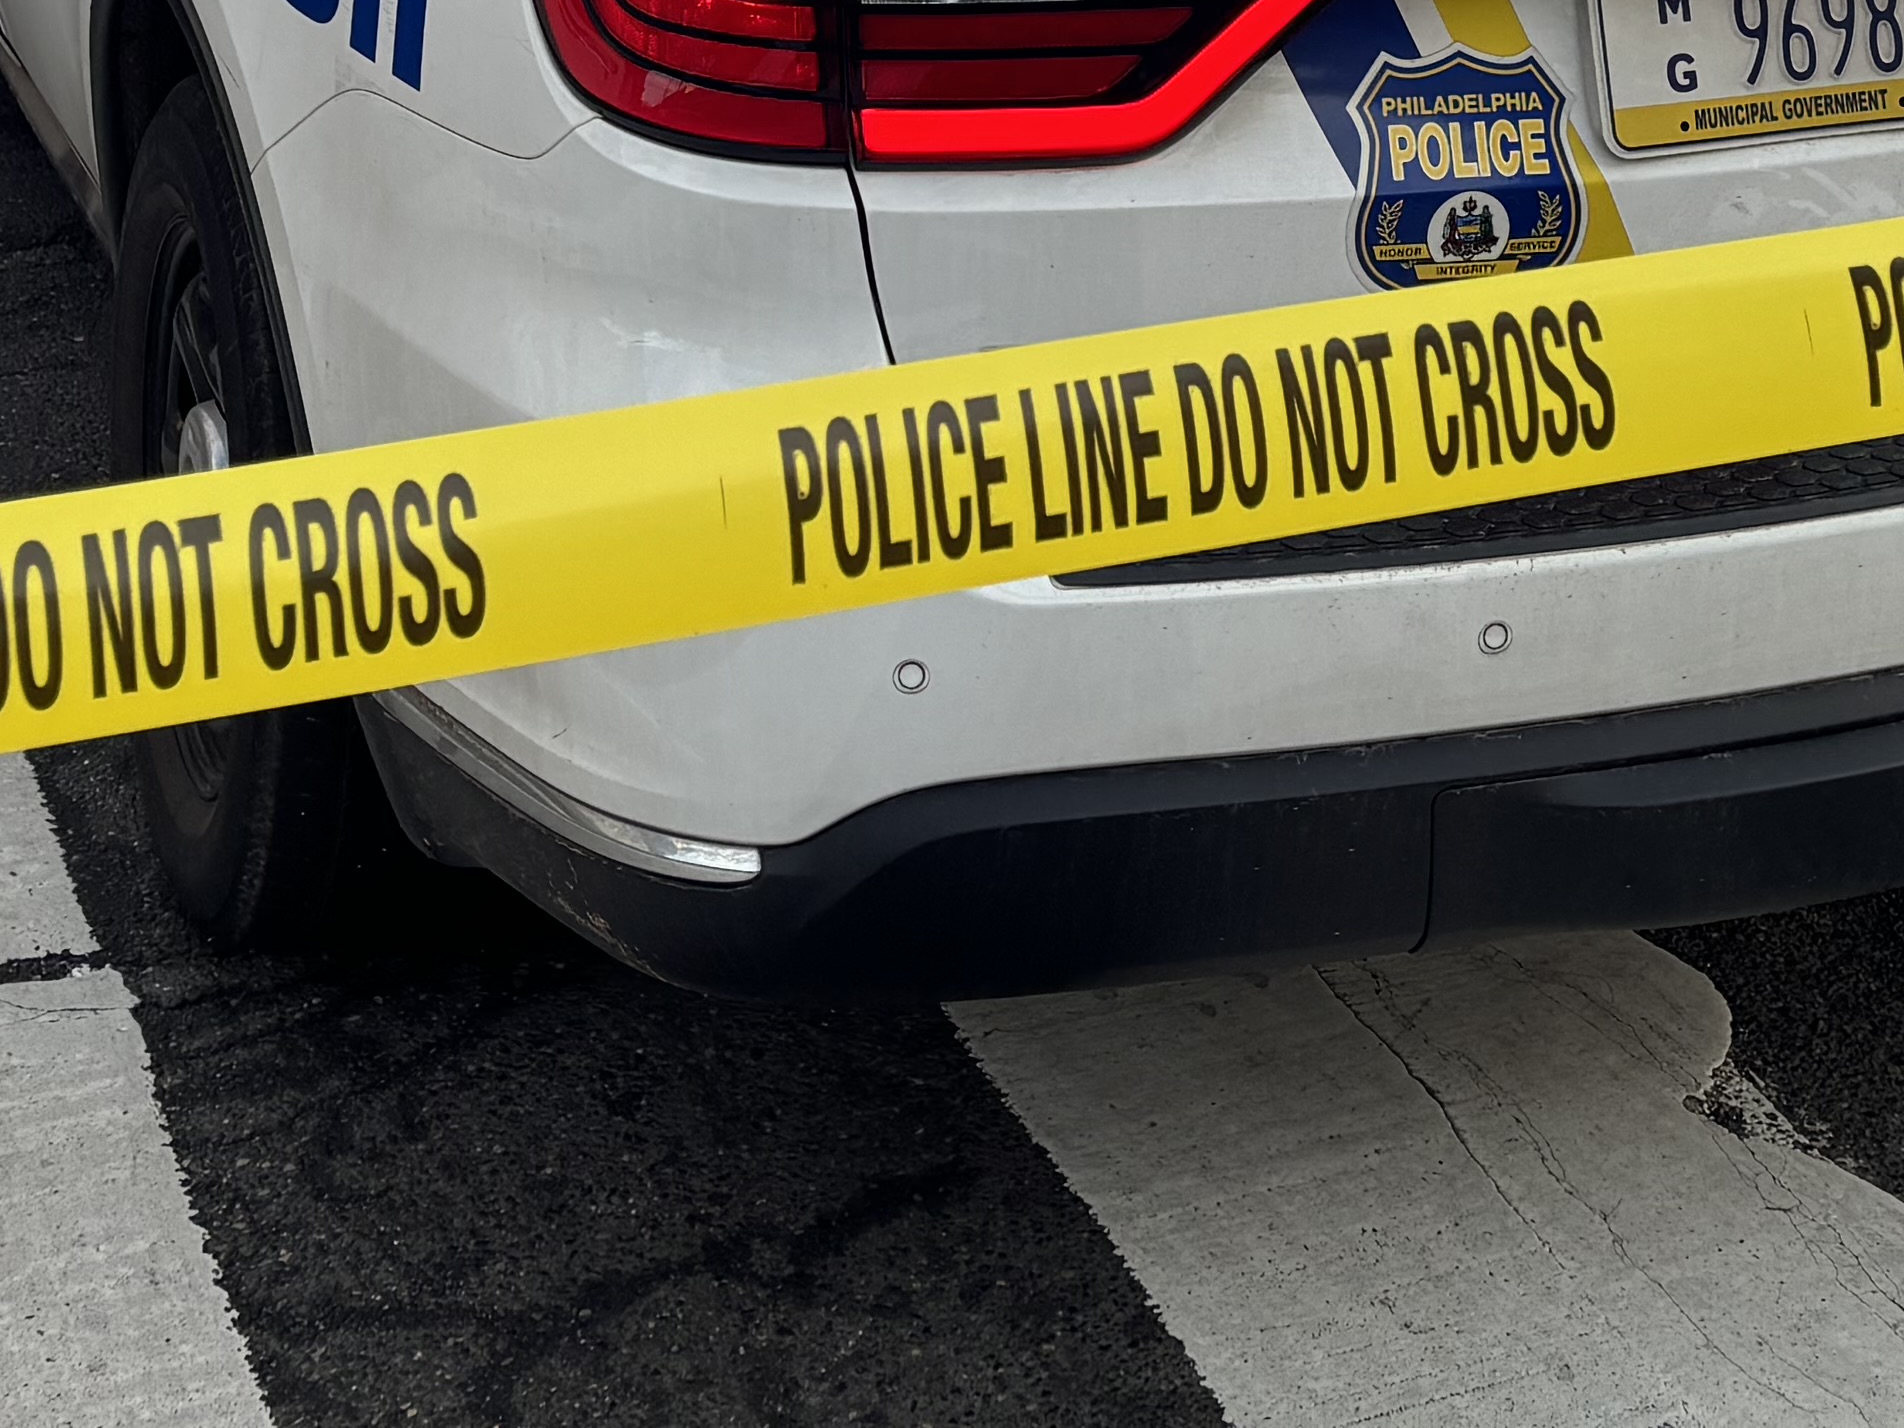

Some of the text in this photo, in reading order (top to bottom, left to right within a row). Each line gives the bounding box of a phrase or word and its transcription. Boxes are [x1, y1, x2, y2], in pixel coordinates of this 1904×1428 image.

[1666, 52, 1698, 93] G
[1381, 92, 1544, 118] PHILADELPHIA
[1694, 88, 1888, 132] MUNICIPAL GOVERNMENT
[1387, 118, 1551, 181] POLICE
[1379, 247, 1423, 258] HONOR
[1509, 240, 1557, 252] SERVICE
[1435, 263, 1497, 277] INTEGRITY
[778, 299, 1616, 586] POLICE LINE DO NOT CROSS
[80, 512, 223, 702] NOT
[247, 471, 486, 672] CROSS
